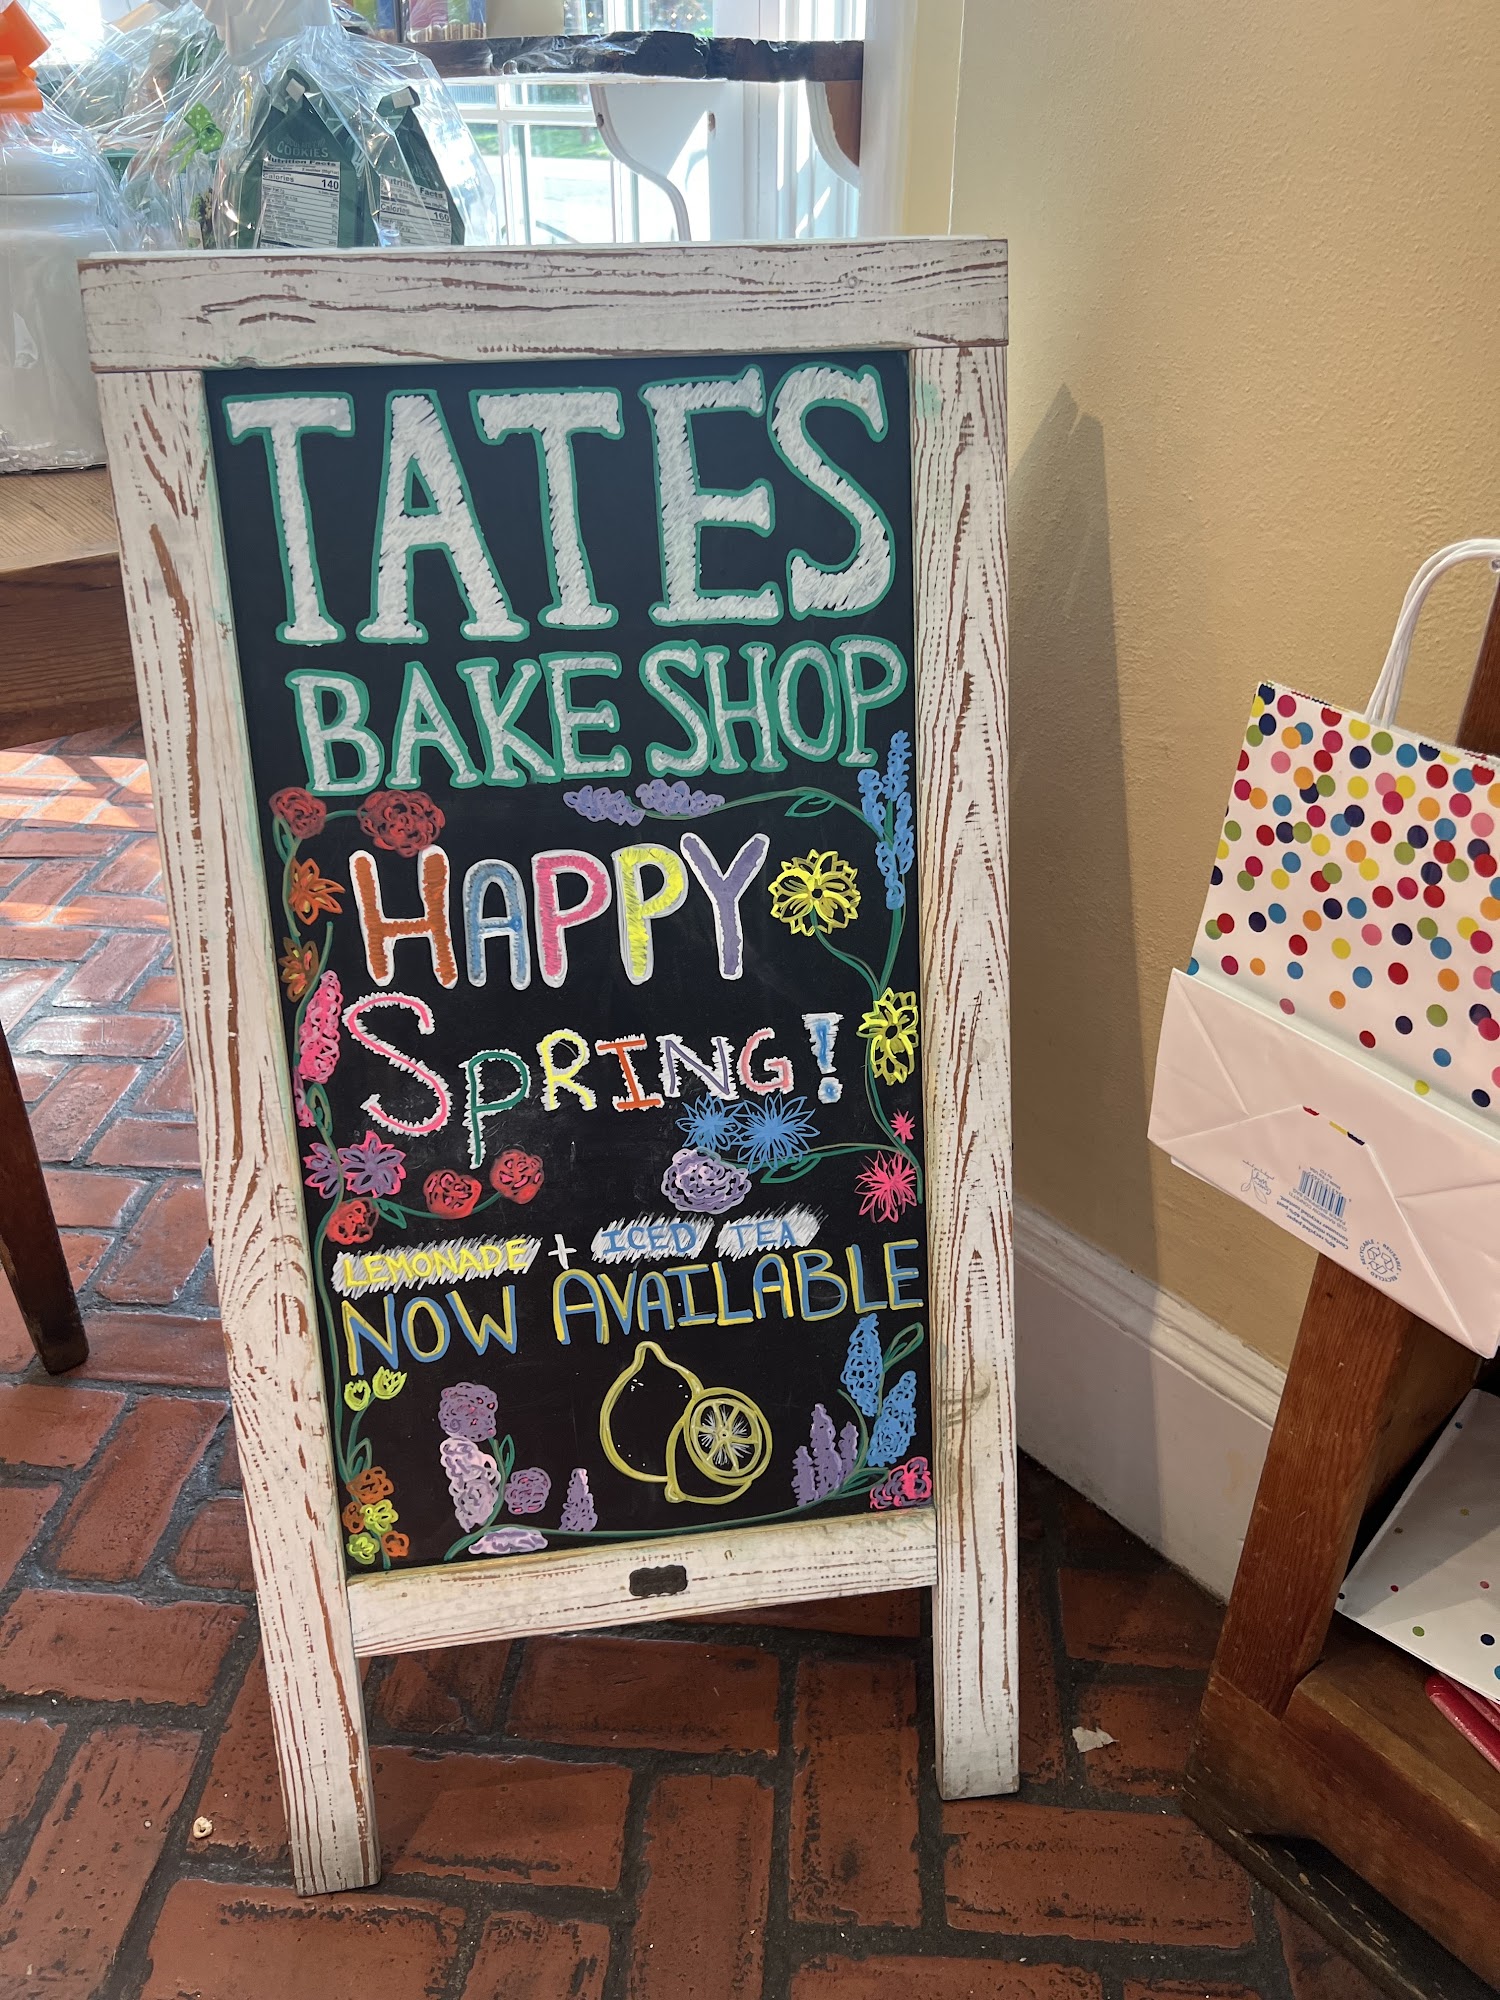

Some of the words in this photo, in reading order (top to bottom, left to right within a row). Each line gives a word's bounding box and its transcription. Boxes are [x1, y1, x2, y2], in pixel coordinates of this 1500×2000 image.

[277, 140, 328, 158] COOKIES
[309, 159, 337, 168] Facts
[262, 173, 295, 183] Calories
[321, 178, 339, 191] 140
[420, 186, 444, 200] Facts
[433, 211, 450, 222] 160
[223, 363, 895, 645] TATES
[285, 652, 631, 795] BAKE
[640, 636, 906, 776] SHOP
[349, 832, 769, 990] HAPPY
[343, 1238, 528, 1287] LEMONADE
[548, 1233, 577, 1270] +
[602, 1222, 696, 1254] ICED
[730, 1222, 797, 1248] TEA
[341, 1285, 518, 1376] NOW
[553, 1239, 924, 1345] AVAILABLE
